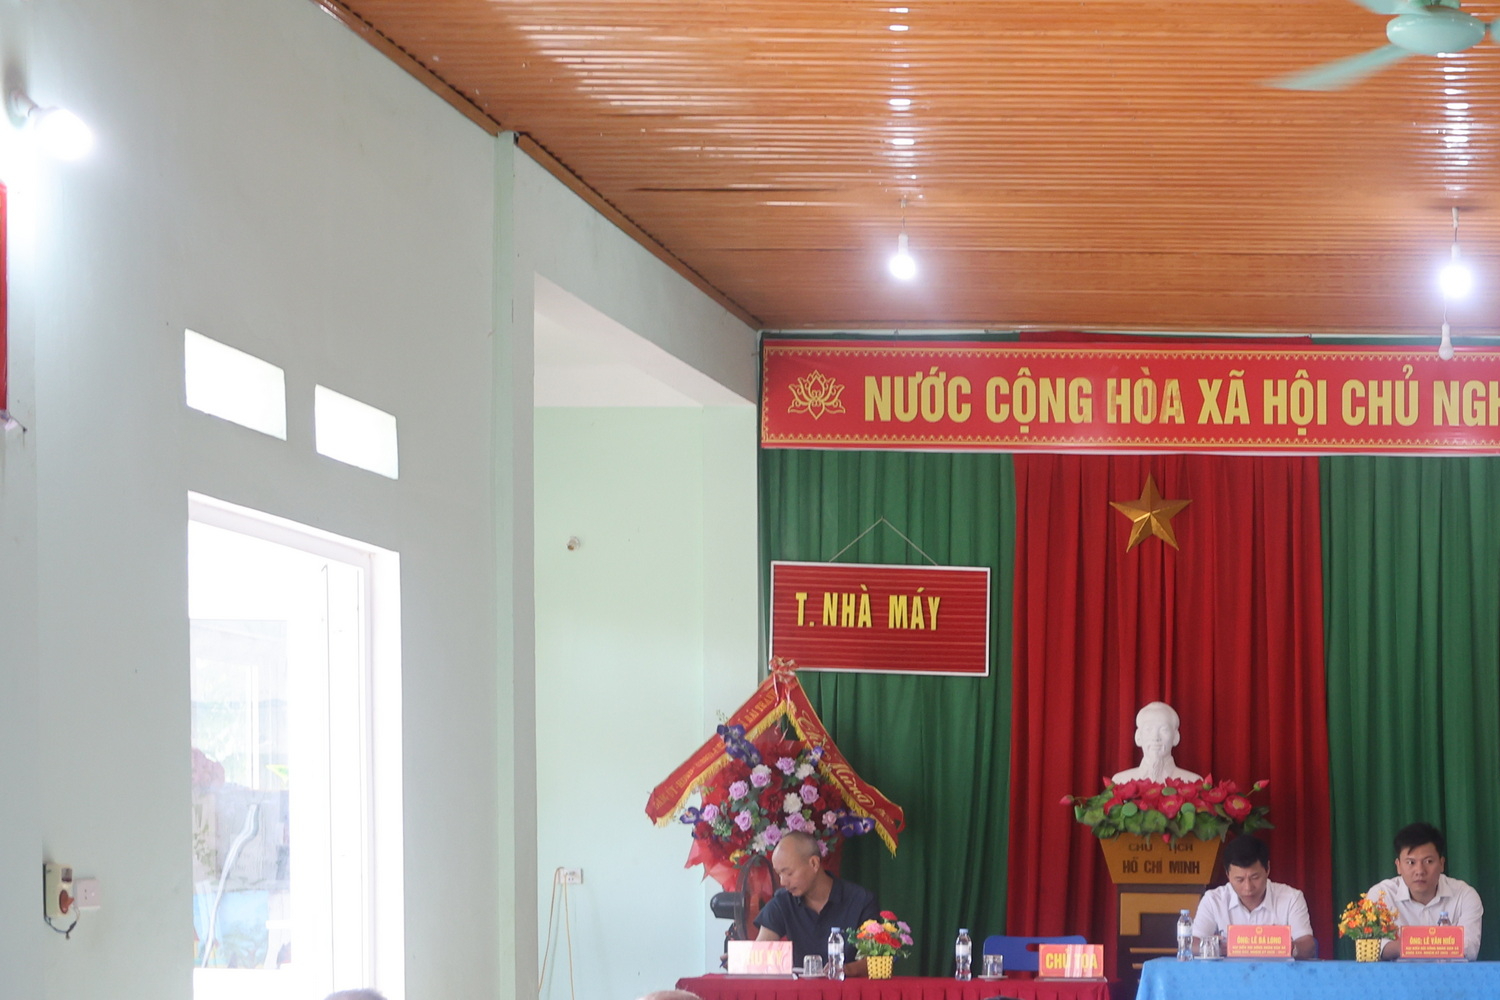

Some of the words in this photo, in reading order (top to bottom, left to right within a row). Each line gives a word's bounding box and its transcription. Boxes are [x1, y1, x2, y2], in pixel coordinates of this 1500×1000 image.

[864, 366, 972, 422] NƯỚC
[985, 367, 1092, 434] CỘNG
[1106, 367, 1183, 425] HÒA
[1197, 369, 1251, 425] XÃ
[1264, 369, 1328, 435] HỘI
[1341, 364, 1419, 427] CHỦ
[822, 584, 873, 629] NHÀ
[888, 588, 941, 631] MÁY
[1123, 857, 1138, 873] HỒ
[1144, 857, 1162, 874] CHÍ
[1169, 860, 1200, 875] MINH
[1045, 948, 1071, 969] CHỦ
